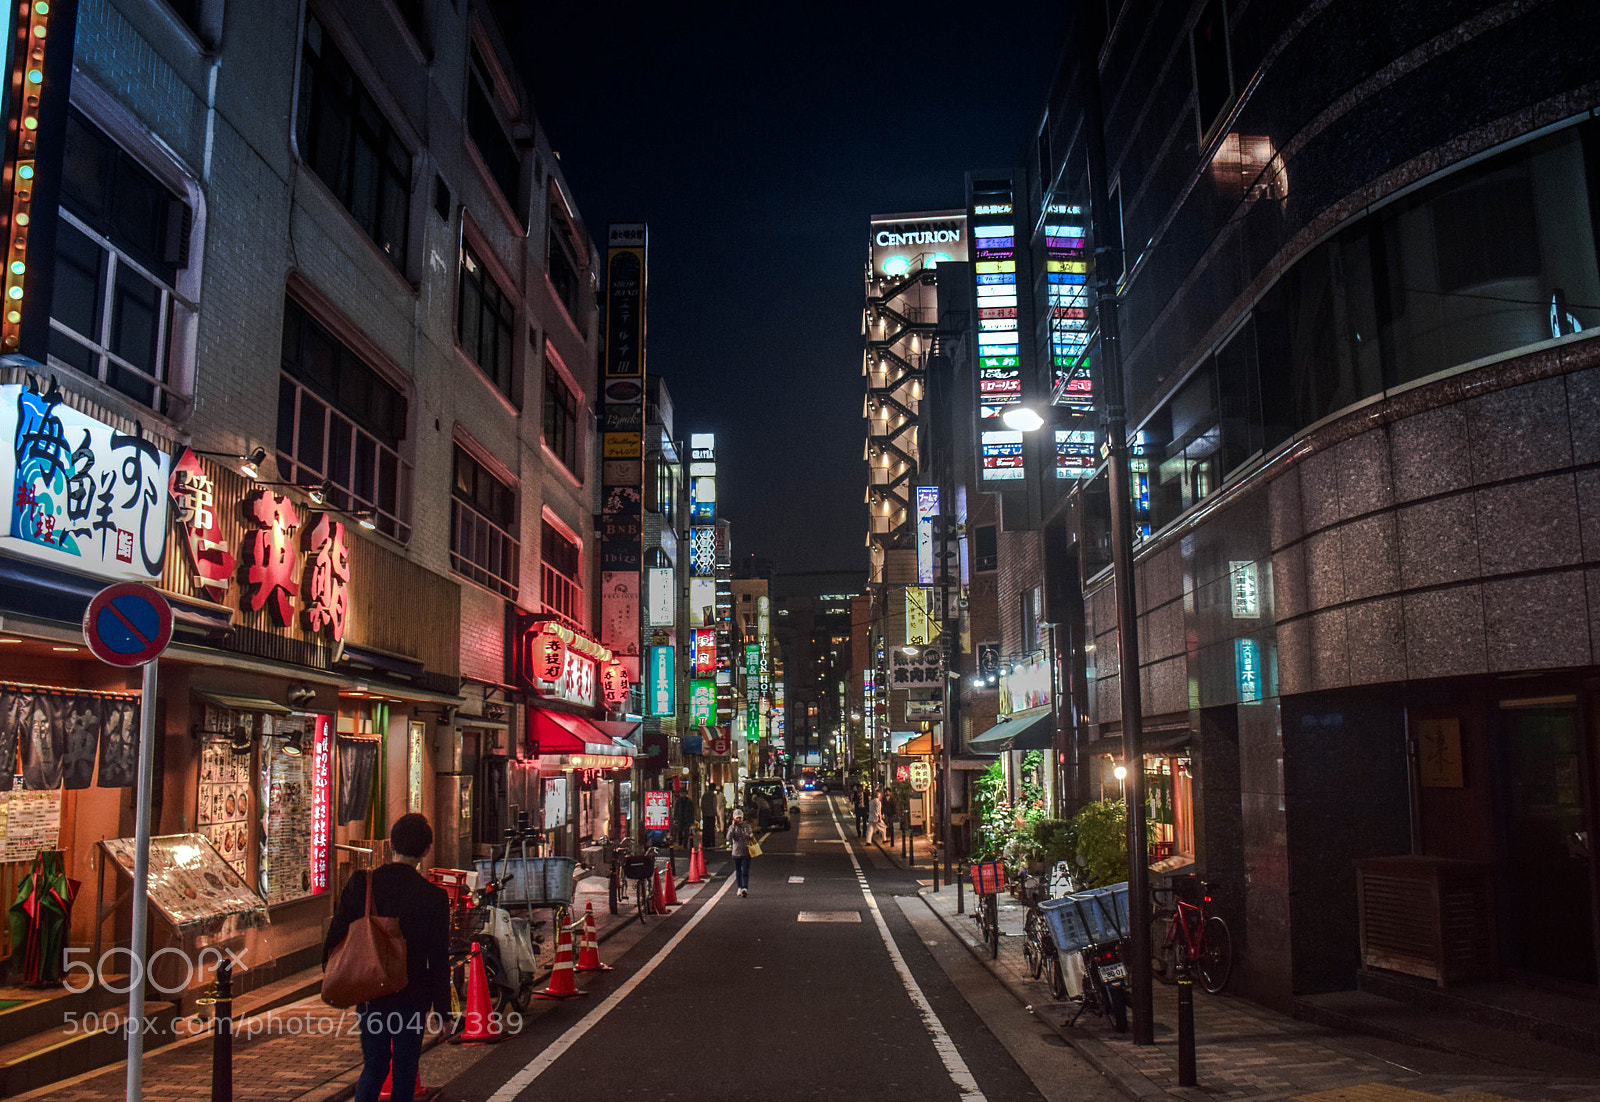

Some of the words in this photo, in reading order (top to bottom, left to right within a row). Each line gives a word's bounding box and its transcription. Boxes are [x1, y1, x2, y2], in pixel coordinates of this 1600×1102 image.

[876, 229, 960, 247] CENTURION
[987, 381, 1018, 391] ローリエ
[16, 480, 56, 546] 料理
[607, 525, 638, 534] BNB
[606, 554, 637, 563] Ibiza
[894, 668, 939, 682] 案内所
